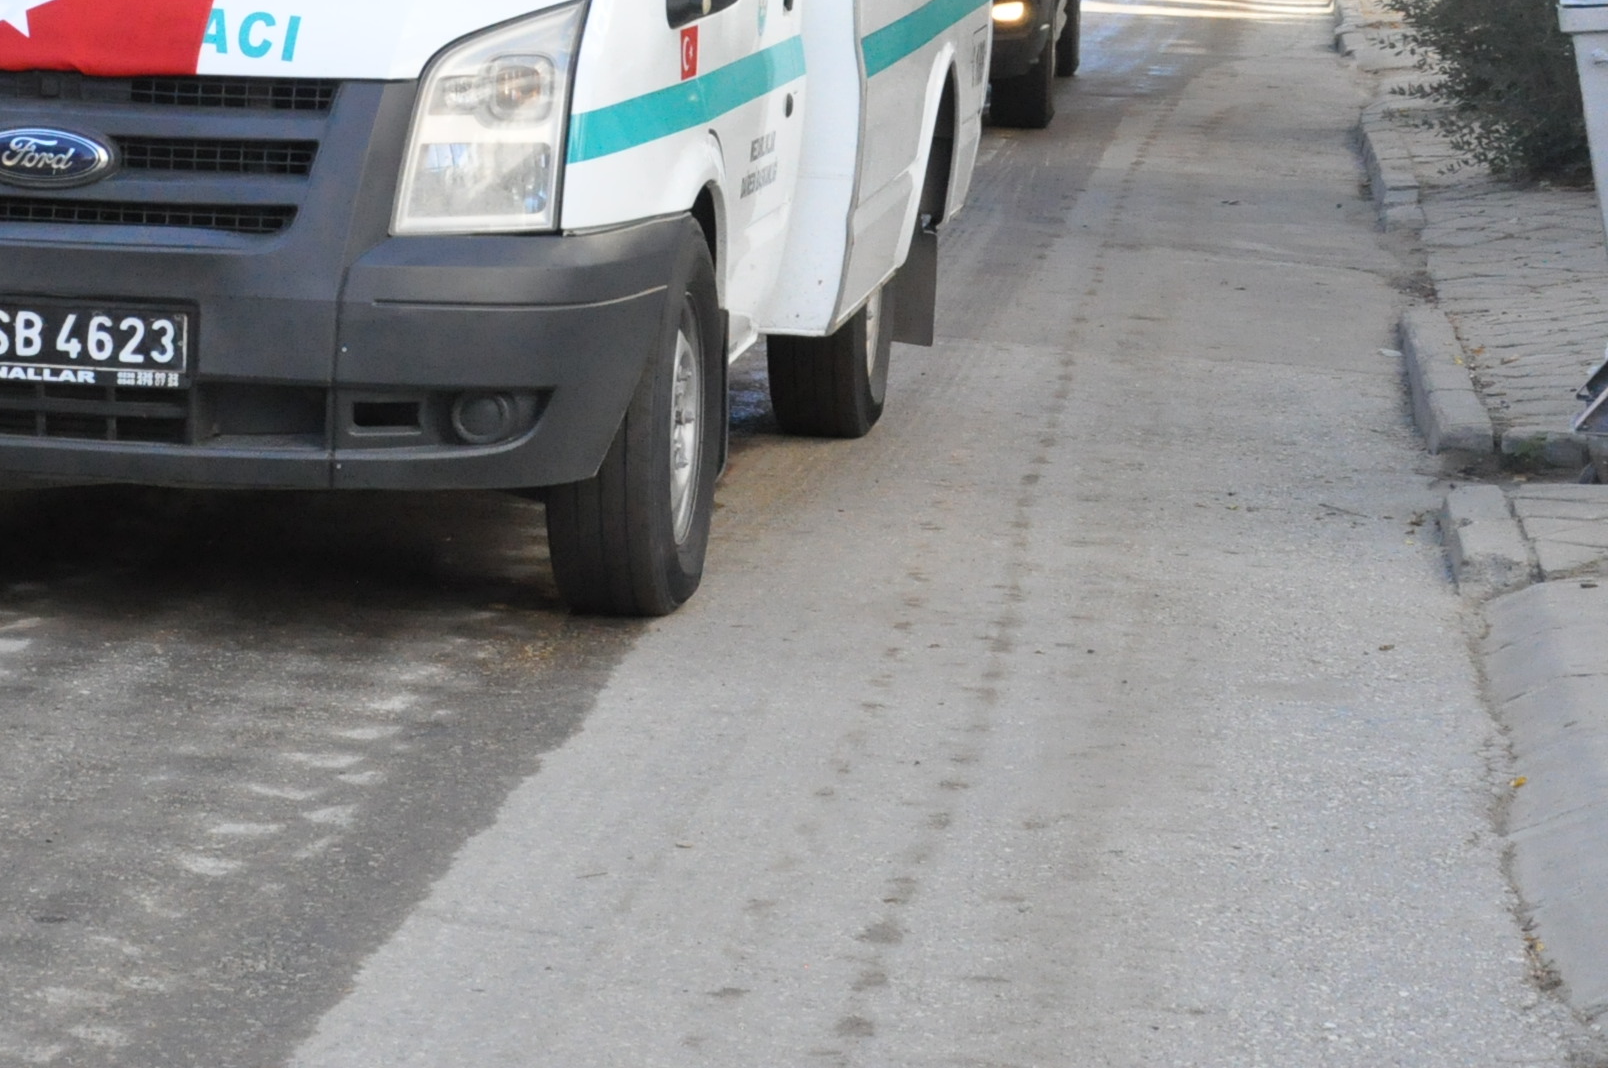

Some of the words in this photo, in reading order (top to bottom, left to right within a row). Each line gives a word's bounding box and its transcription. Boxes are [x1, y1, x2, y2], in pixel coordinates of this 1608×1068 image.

[202, 7, 302, 63] ACI
[1, 136, 76, 170] Ford
[55, 313, 175, 364] 4623
